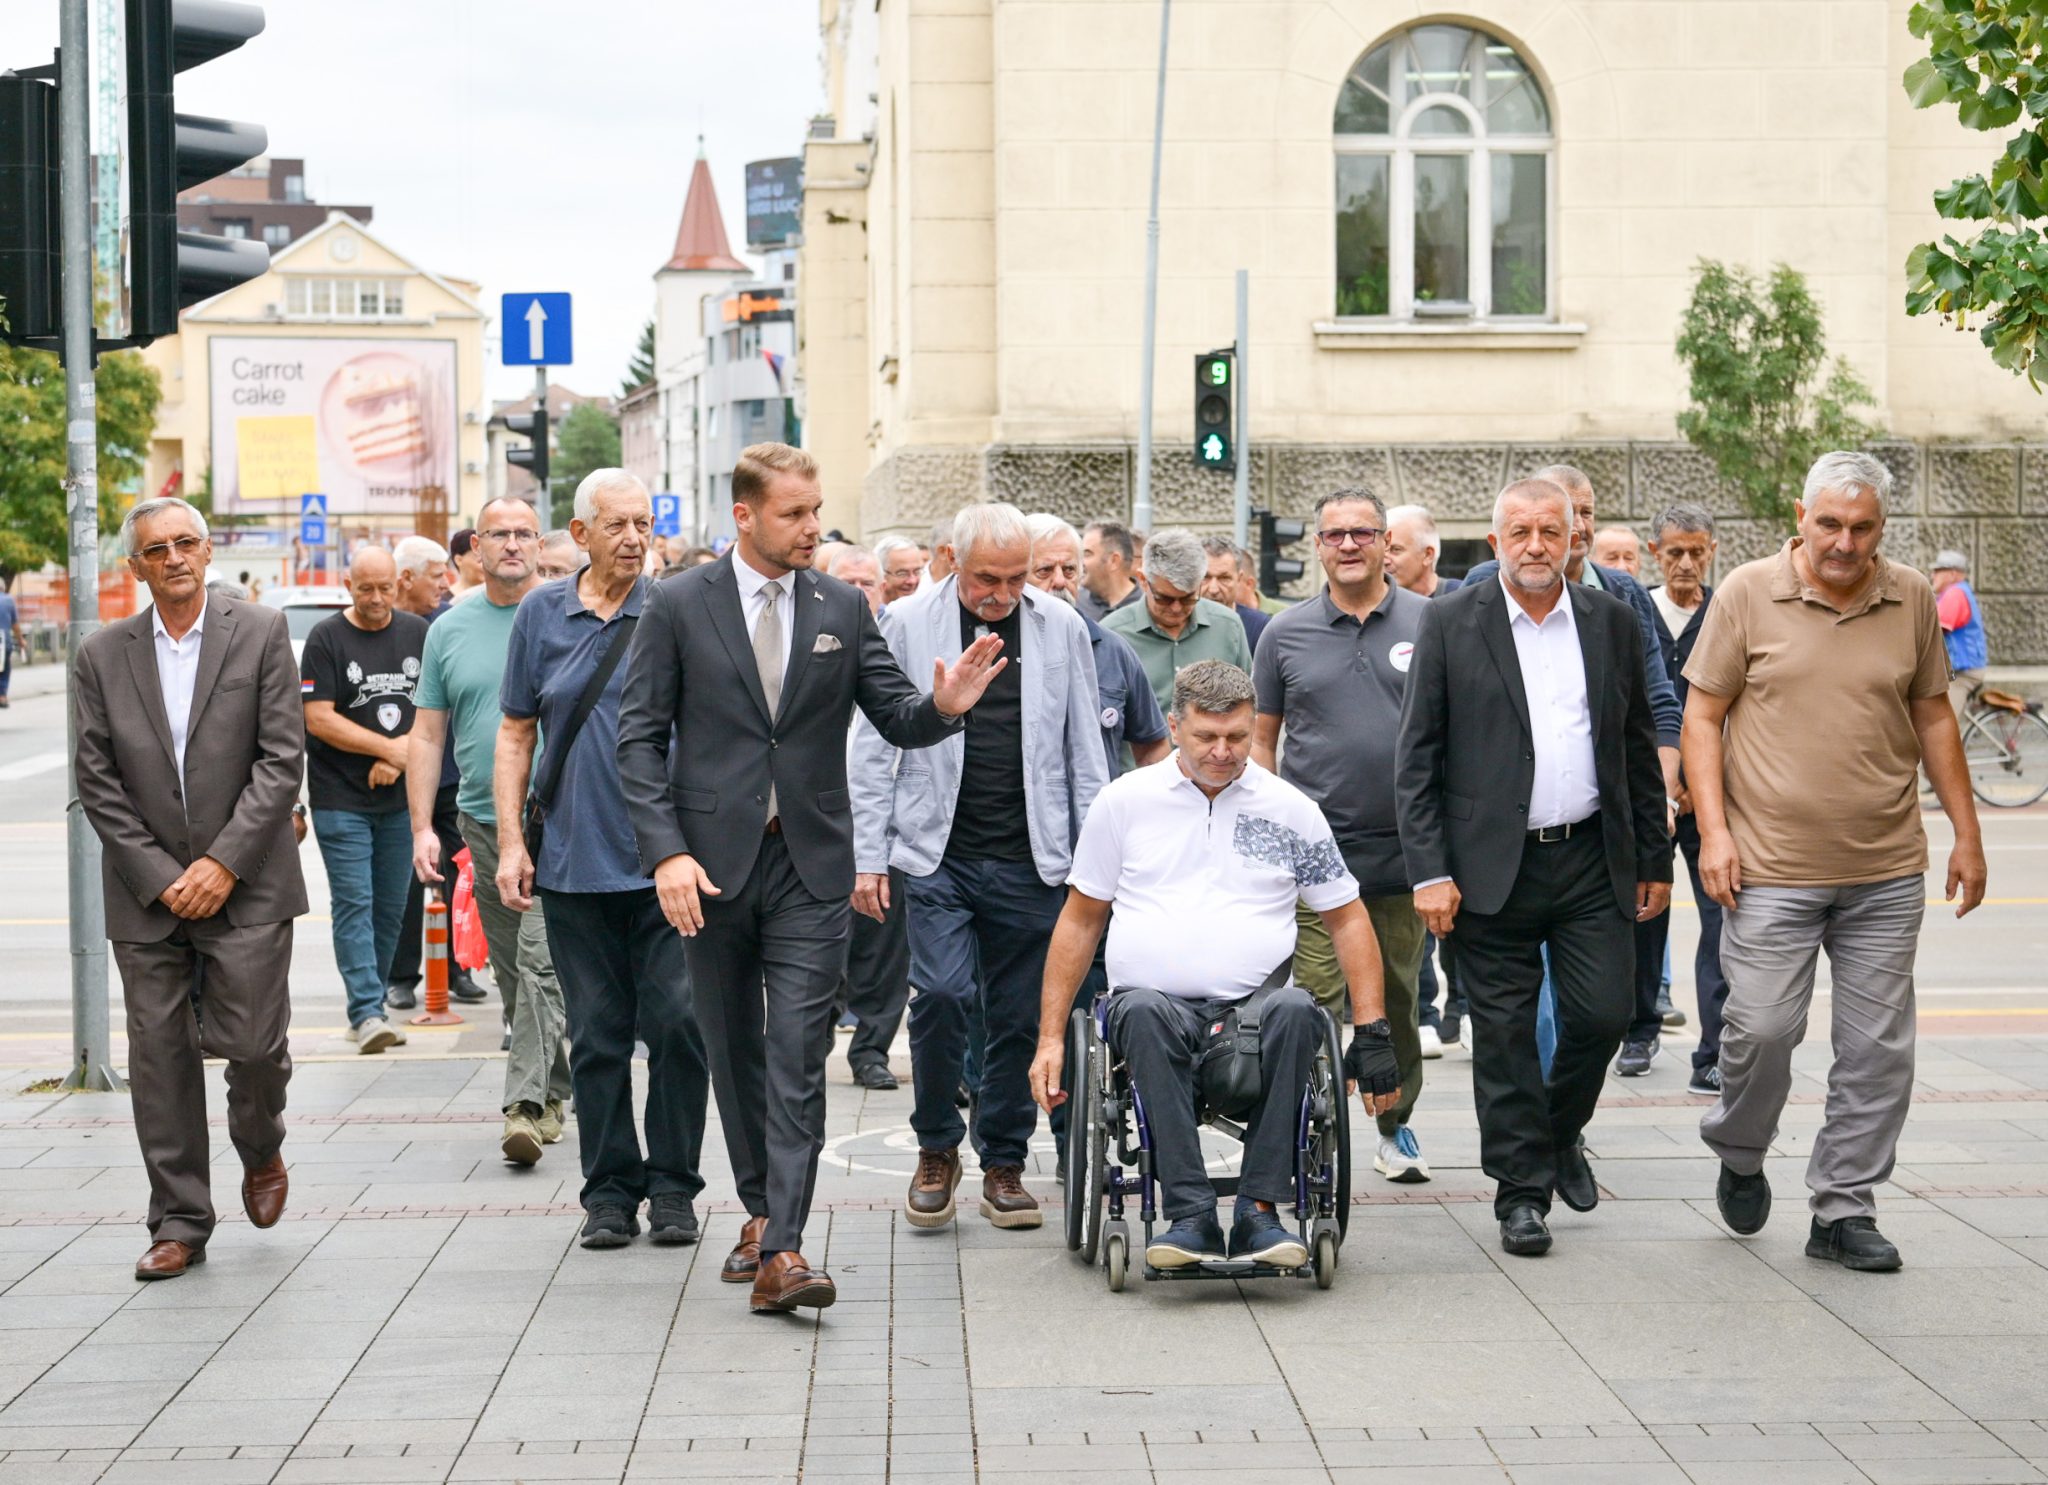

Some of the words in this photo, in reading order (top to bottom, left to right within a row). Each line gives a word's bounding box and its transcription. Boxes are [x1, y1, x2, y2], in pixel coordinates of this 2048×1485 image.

[232, 357, 304, 381] Carrot
[1211, 361, 1227, 385] 9
[232, 383, 286, 406] cake
[657, 497, 675, 520] P
